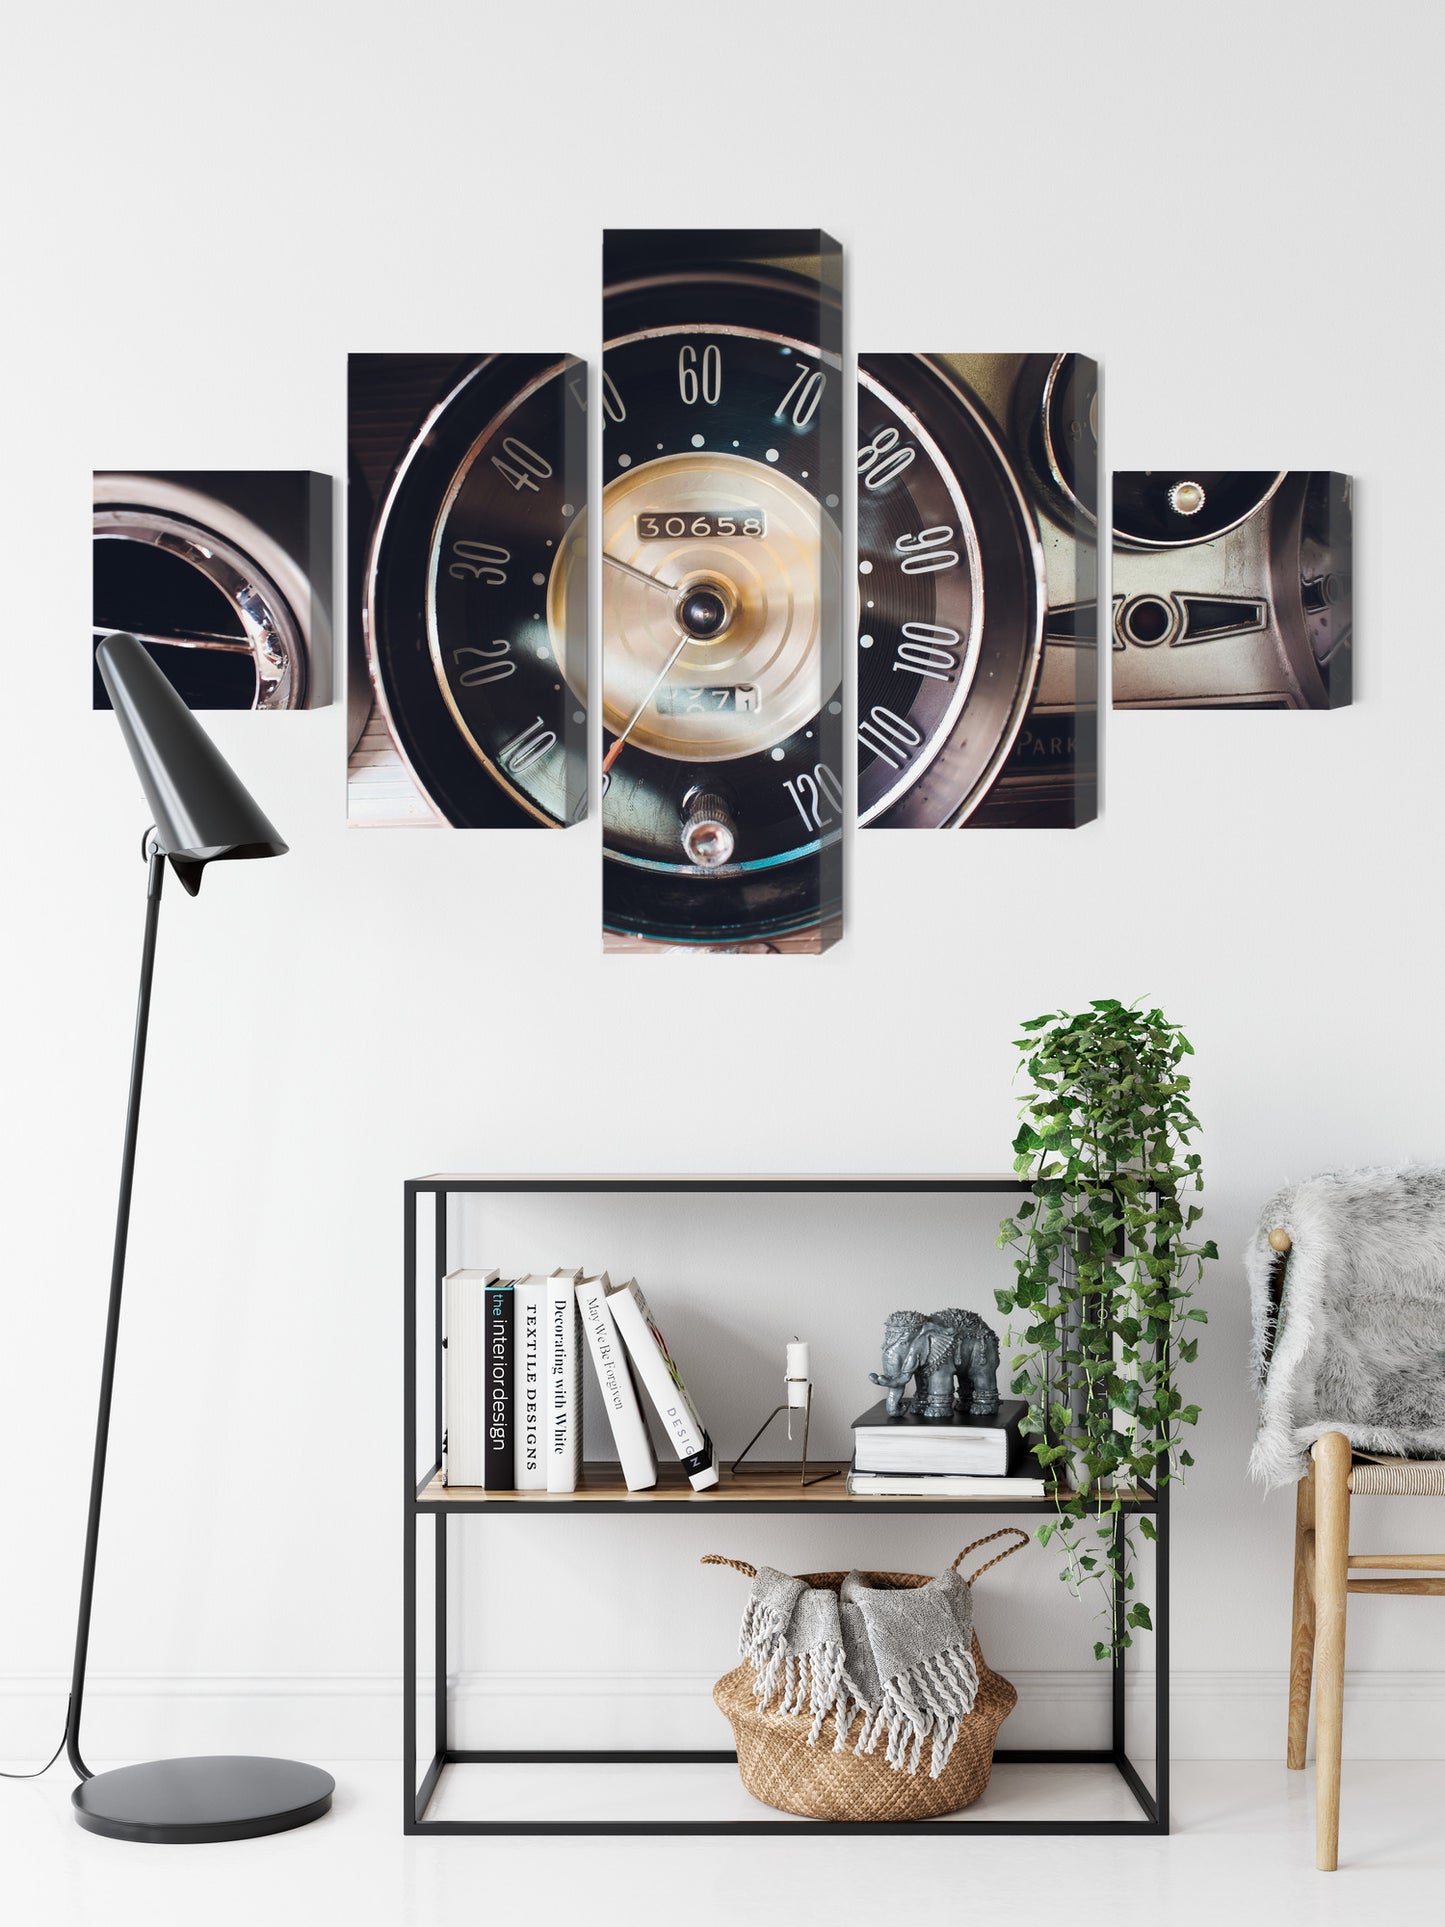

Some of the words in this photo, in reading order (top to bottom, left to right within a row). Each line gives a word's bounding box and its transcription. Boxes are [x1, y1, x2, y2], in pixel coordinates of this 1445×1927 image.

[678, 344, 722, 405] 60
[774, 363, 827, 428] 70
[490, 435, 554, 494] 40
[857, 426, 916, 491] 80
[640, 516, 762, 538] 30658
[895, 525, 960, 576] 90
[448, 539, 512, 586] 30
[453, 638, 518, 688] 20
[892, 621, 962, 683] 100
[497, 715, 558, 775] 10
[857, 704, 924, 771] 110
[782, 762, 843, 834] 120
[492, 1294, 504, 1316] the
[586, 1297, 600, 1322] May
[594, 1322, 607, 1343] We
[526, 1303, 538, 1383] TEXTILE
[551, 1300, 567, 1375] Decorating
[600, 1344, 611, 1360] Be
[554, 1379, 567, 1409] with
[604, 1361, 624, 1411] Forgiven
[526, 1389, 538, 1472] DESIGNS
[554, 1412, 567, 1455] White
[667, 1407, 701, 1468] DESIGN
